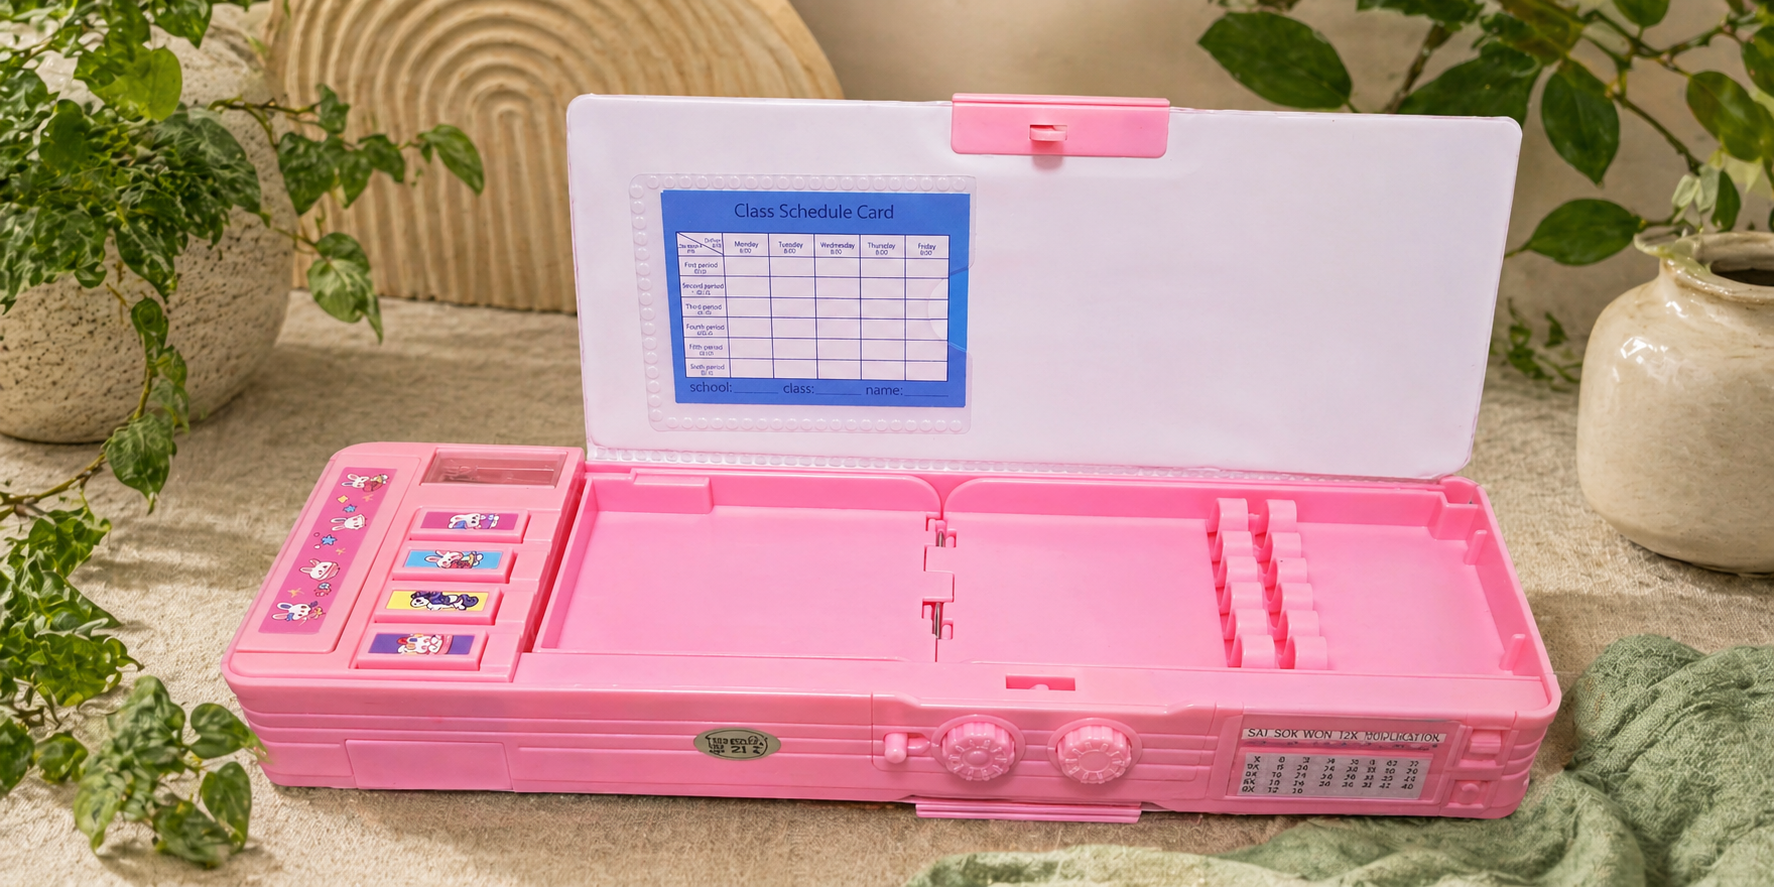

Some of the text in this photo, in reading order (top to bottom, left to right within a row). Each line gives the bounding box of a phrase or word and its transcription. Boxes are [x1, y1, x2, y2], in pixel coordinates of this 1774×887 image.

[734, 203, 894, 219] Class Schedule Card
[778, 241, 803, 249] Tuesday
[868, 242, 896, 250] Thursday
[690, 382, 903, 396] school: class: name:
[1303, 730, 1332, 739] WON
